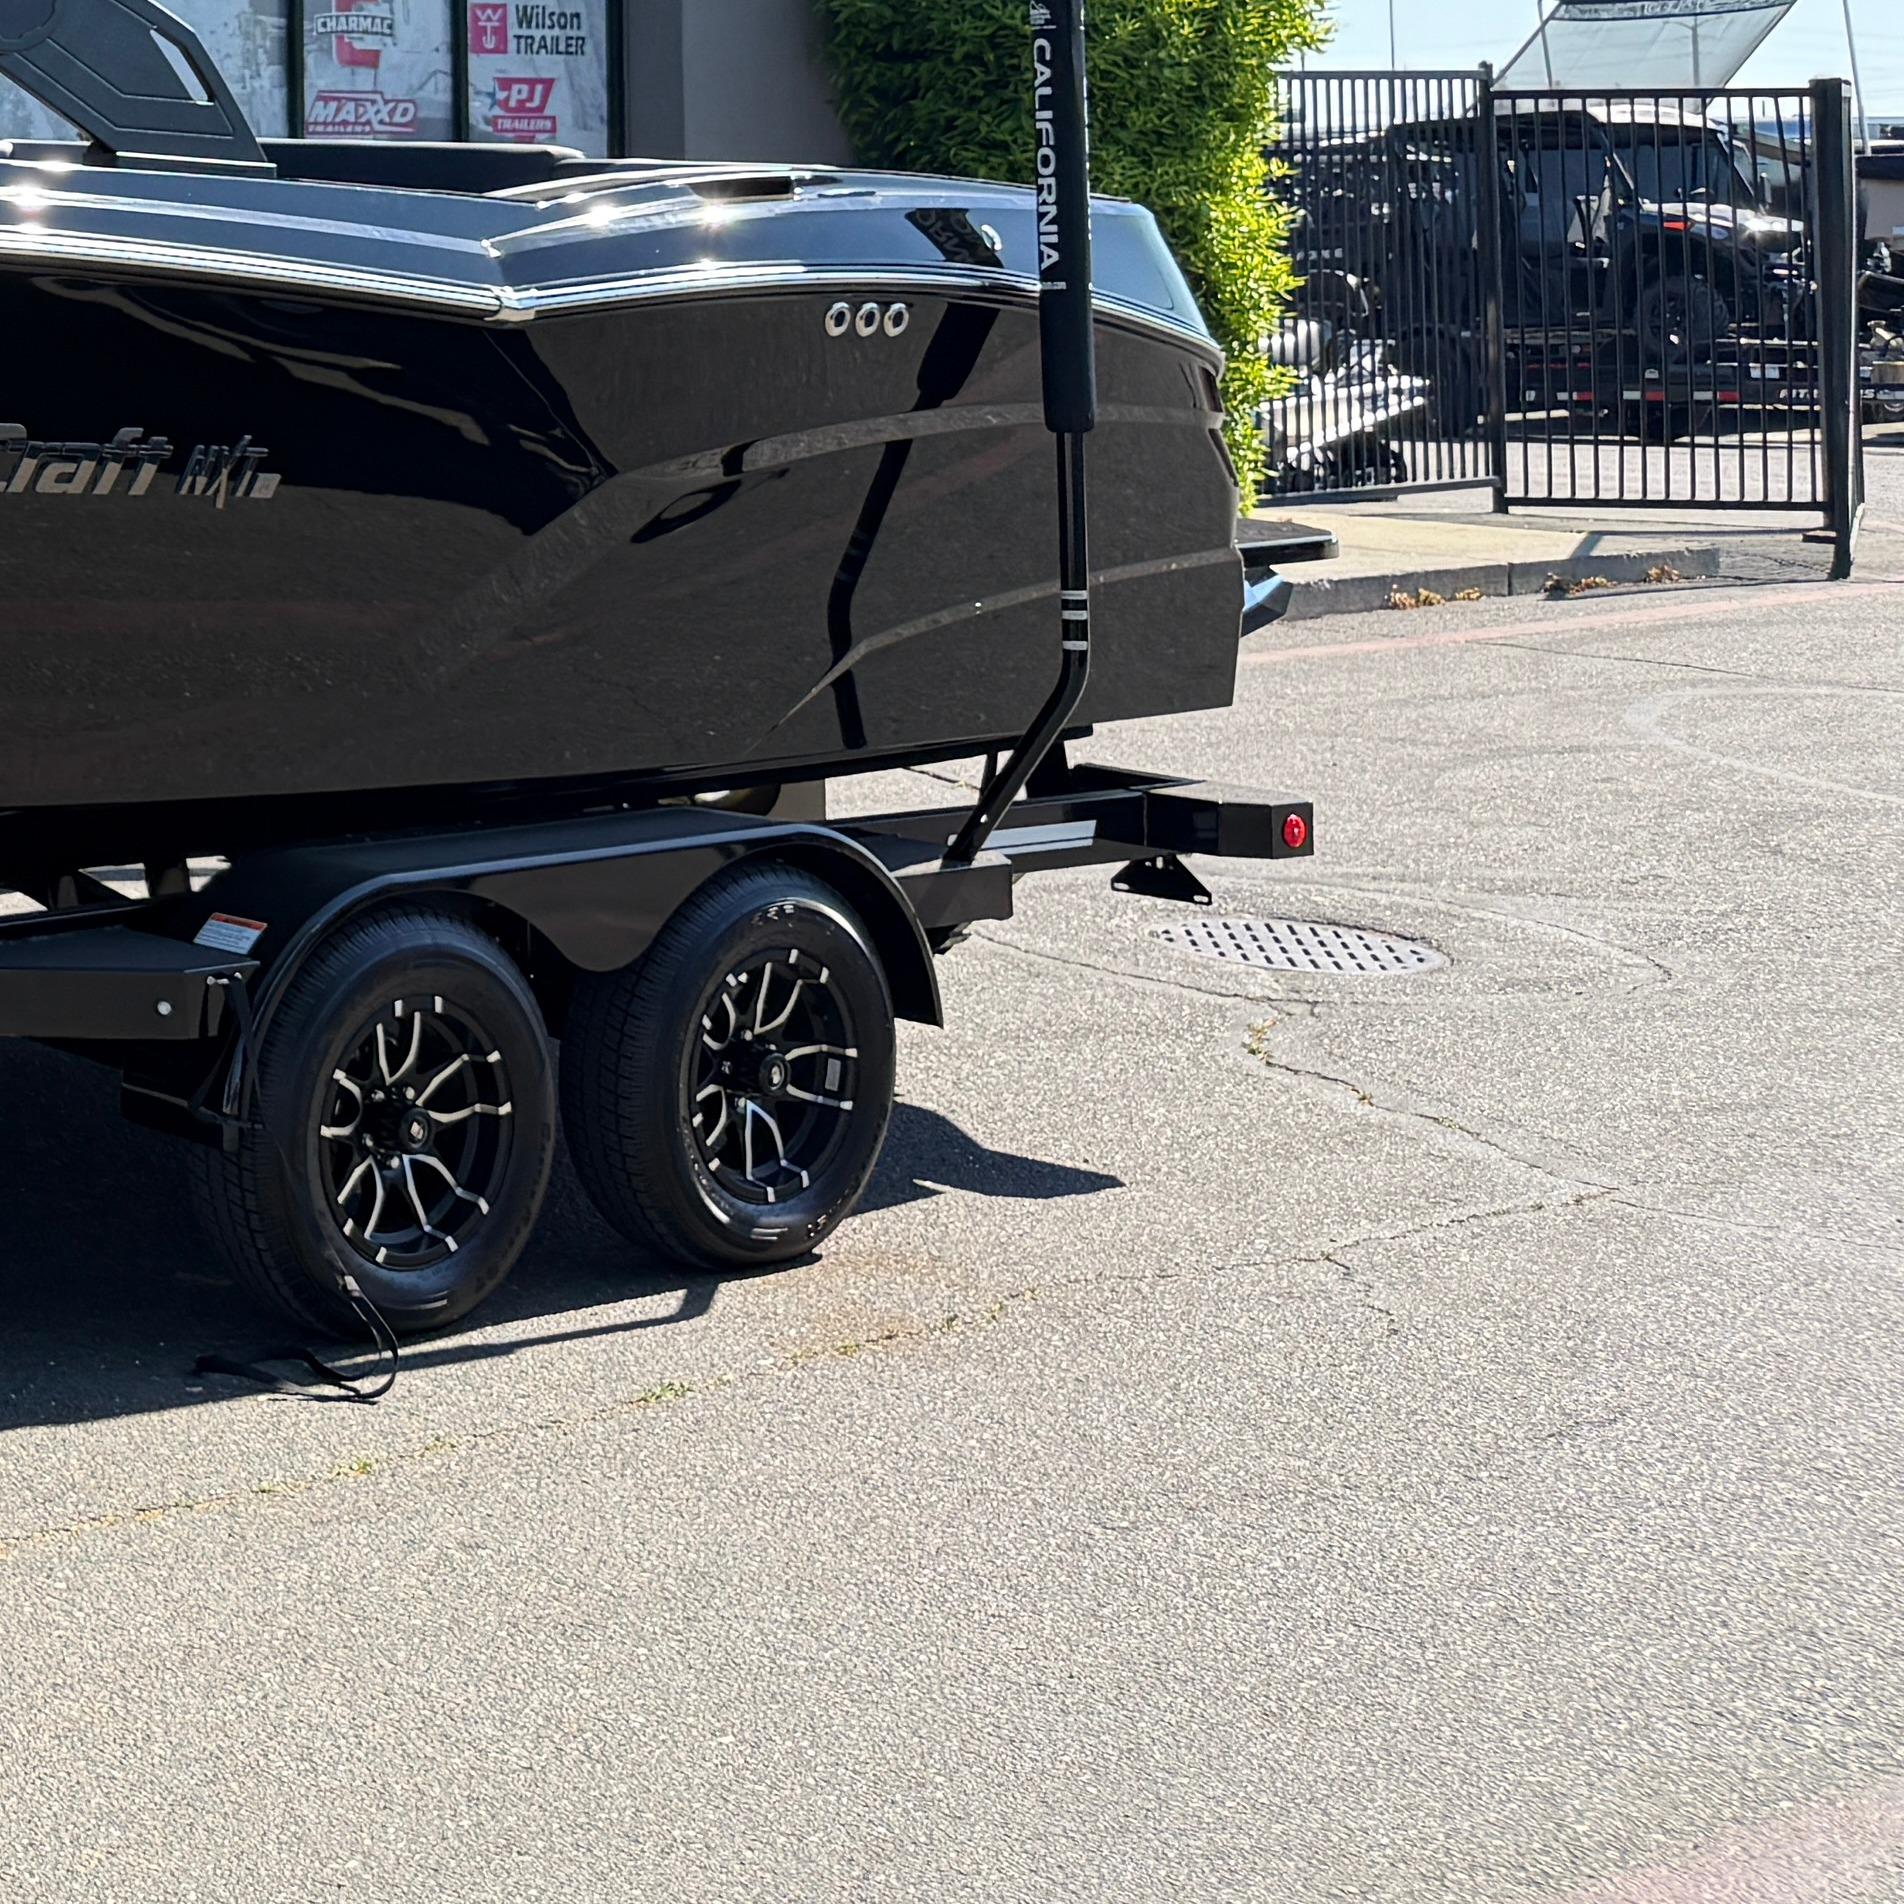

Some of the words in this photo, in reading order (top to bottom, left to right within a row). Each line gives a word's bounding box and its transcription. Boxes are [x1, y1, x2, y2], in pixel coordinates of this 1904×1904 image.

[315, 14, 395, 36] CHARMAC
[514, 3, 582, 30] Wilson
[513, 34, 586, 56] TRAILER
[508, 83, 545, 110] PJ
[495, 117, 553, 131] TRAILERS
[1034, 37, 1060, 271] CALIFORNIA
